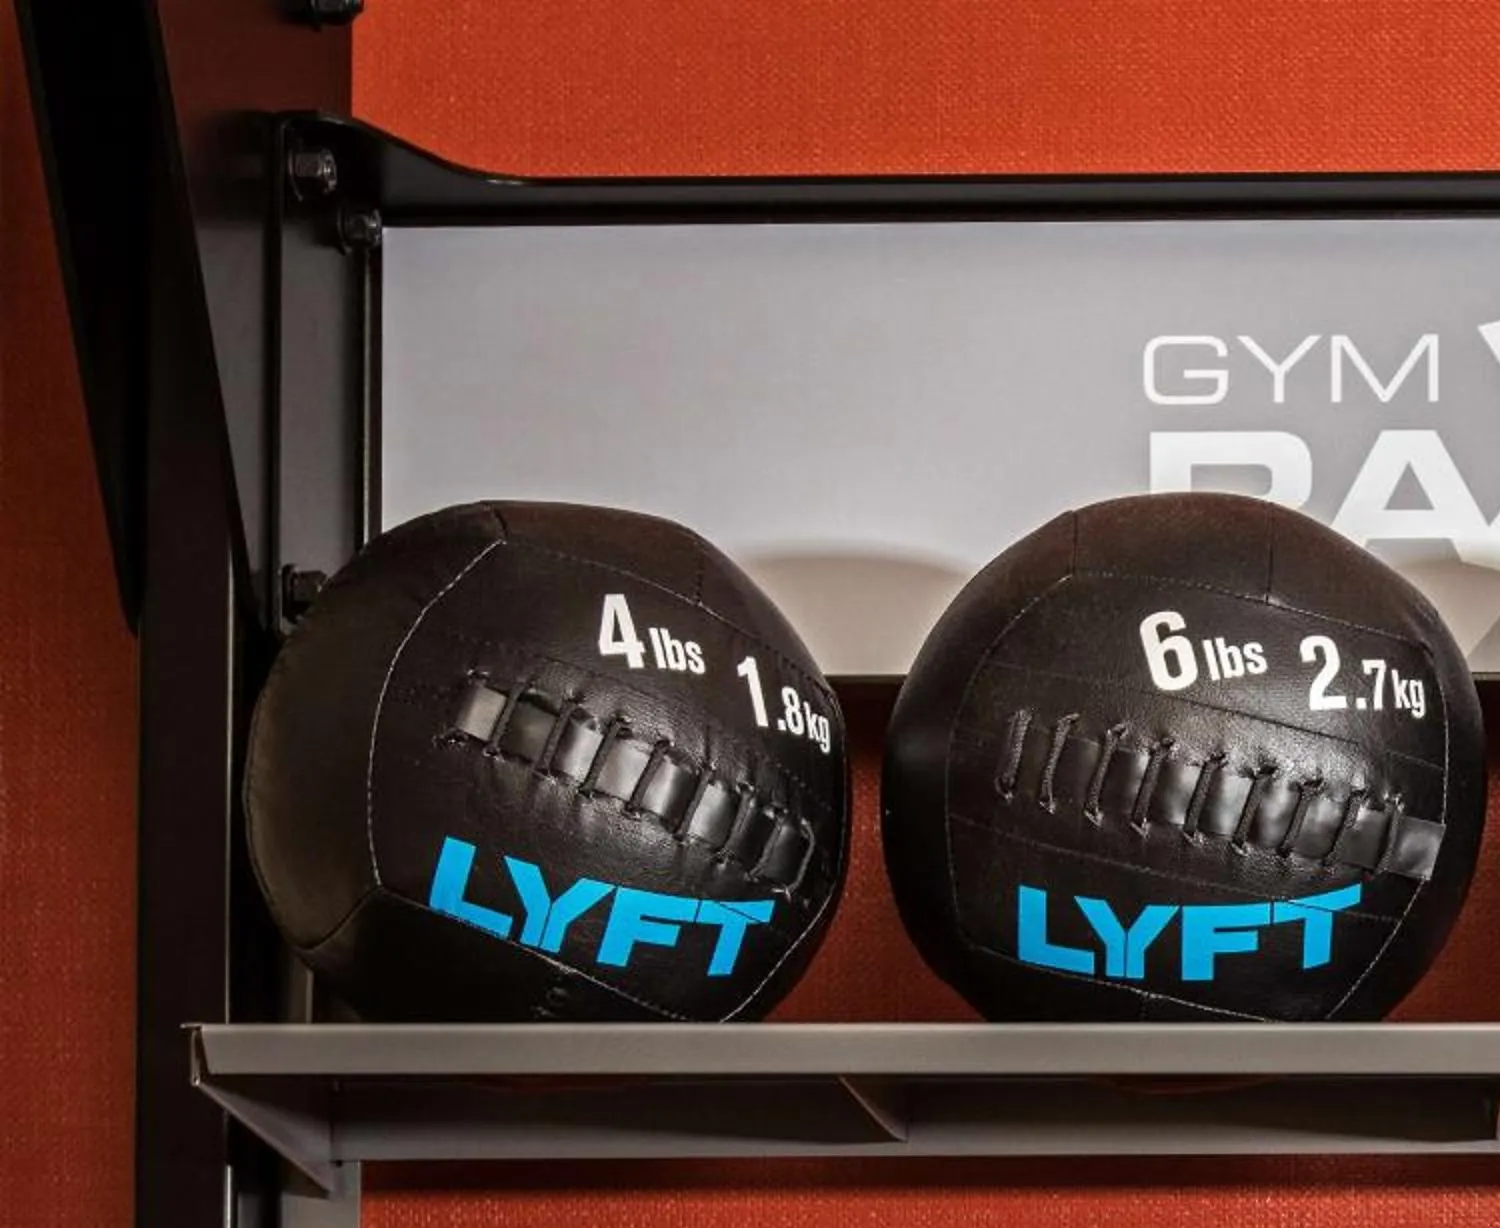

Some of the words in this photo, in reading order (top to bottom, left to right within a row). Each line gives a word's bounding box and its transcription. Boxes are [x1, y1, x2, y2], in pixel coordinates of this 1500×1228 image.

[1142, 333, 1439, 405] GYM
[428, 835, 776, 976] LYFT
[1017, 883, 1362, 981] LYFT
